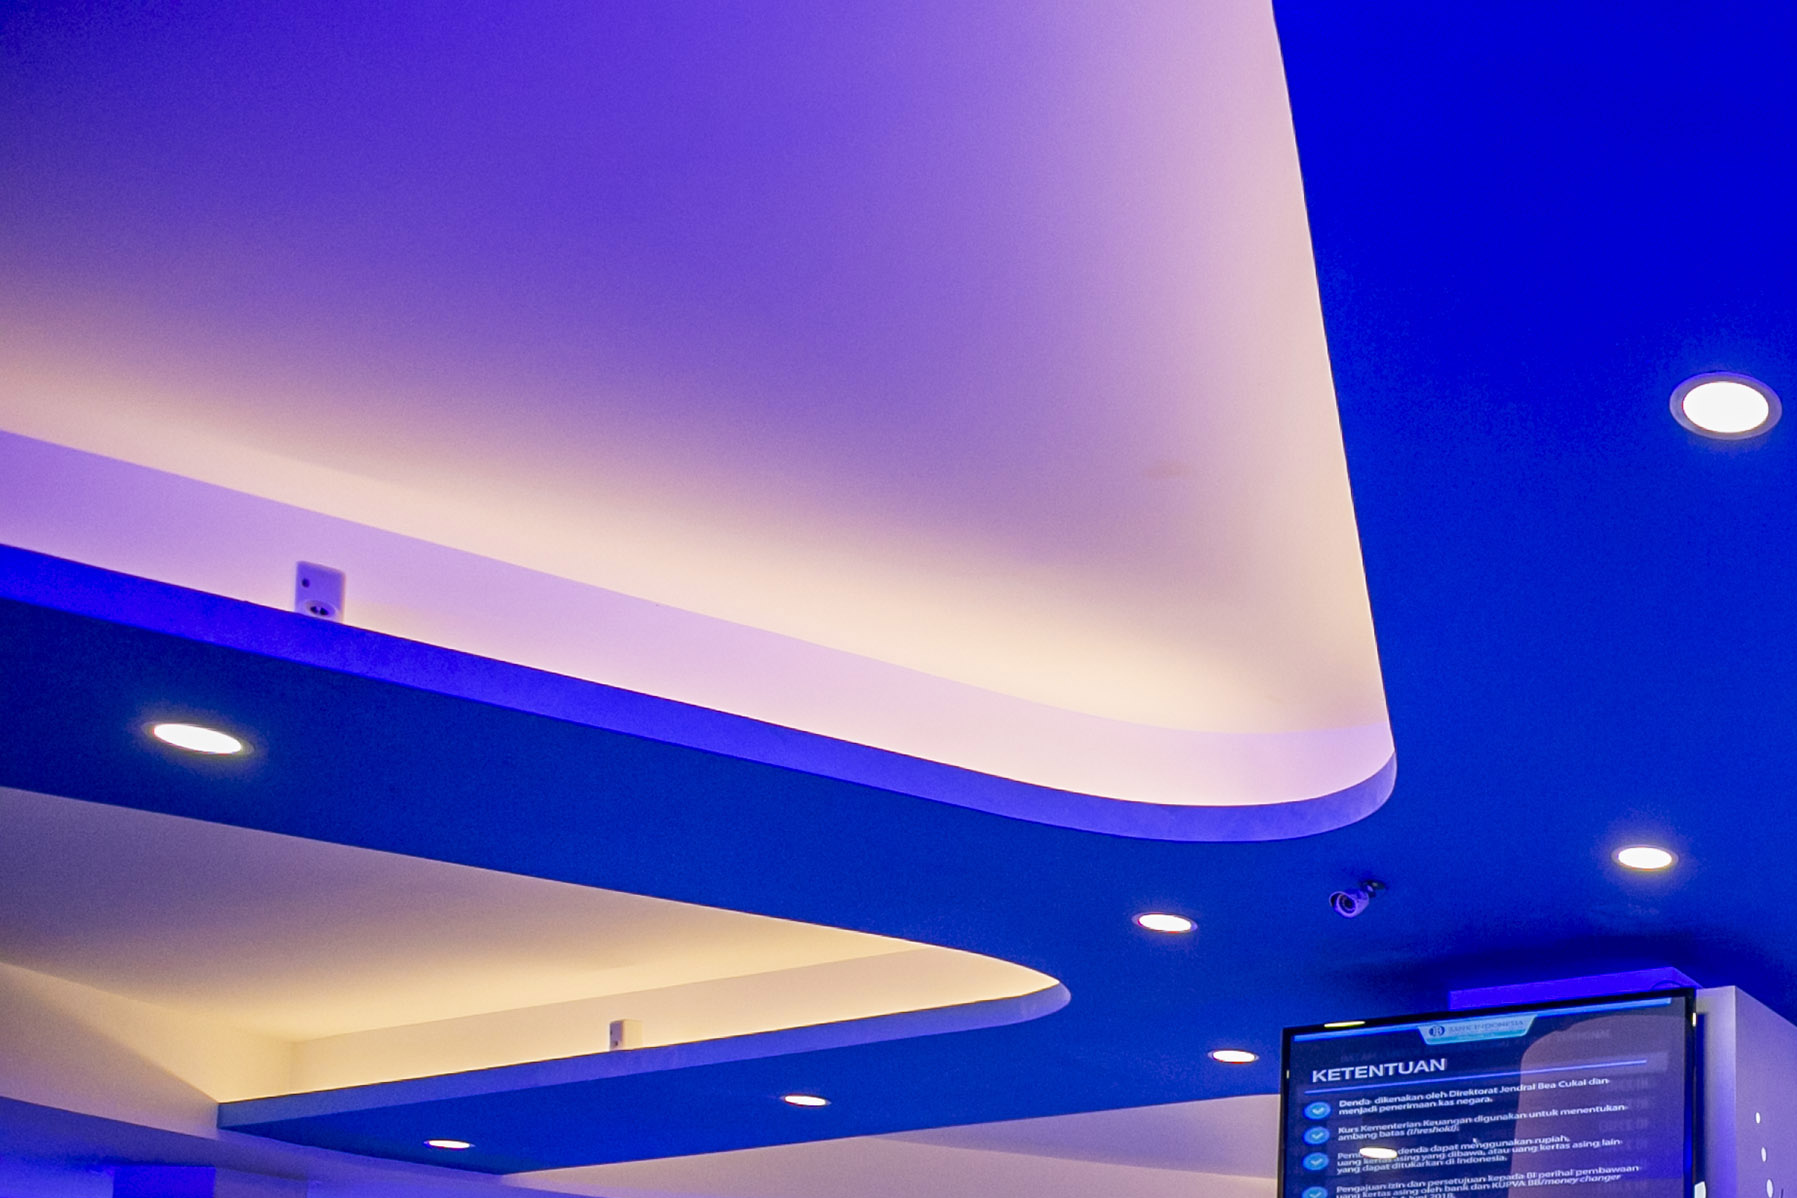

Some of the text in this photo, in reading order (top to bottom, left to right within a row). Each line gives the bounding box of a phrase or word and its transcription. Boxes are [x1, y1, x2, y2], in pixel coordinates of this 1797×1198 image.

[1312, 1058, 1447, 1083] KETENTUAN
[1338, 1077, 1608, 1108] Denda dikenakan oleh Direktorat Jendral Bea Cukai dan
[1338, 1096, 1493, 1116] menjadi penerimaan kas negara.
[1338, 1104, 1625, 1135] Kurs Kementerian Keuangan digunakan untuk menentukan
[1338, 1132, 1377, 1142] ambang
[1379, 1129, 1405, 1138] batas
[1398, 1145, 1428, 1155] denda
[1430, 1143, 1458, 1153] dapat
[1460, 1138, 1533, 1151] menggunakan
[1337, 1158, 1359, 1167] uang
[1421, 1152, 1446, 1161] yang
[1488, 1147, 1509, 1155] atau
[1512, 1146, 1537, 1155] uang
[1539, 1142, 1570, 1151] kertas
[1572, 1140, 1600, 1149] asing
[1602, 1138, 1621, 1146] lain
[1337, 1166, 1360, 1175] yang
[1362, 1163, 1390, 1173] dapat
[1391, 1159, 1443, 1170] ditukarkan
[1445, 1158, 1455, 1166] di
[1336, 1184, 1387, 1195] Pengajuan
[1388, 1182, 1405, 1190] izin
[1407, 1180, 1426, 1189] dan
[1427, 1177, 1486, 1188] persetujuan
[1488, 1173, 1524, 1184] kepada
[1539, 1170, 1573, 1180] perihal
[1575, 1166, 1639, 1177] pembawaan
[1362, 1191, 1391, 1198] kertas
[1393, 1188, 1419, 1197] asing
[1421, 1186, 1442, 1194] oleh
[1444, 1184, 1469, 1192] bank
[1470, 1183, 1490, 1191] dan
[1492, 1180, 1526, 1190] KUPVA
[1580, 1175, 1621, 1184] changer
